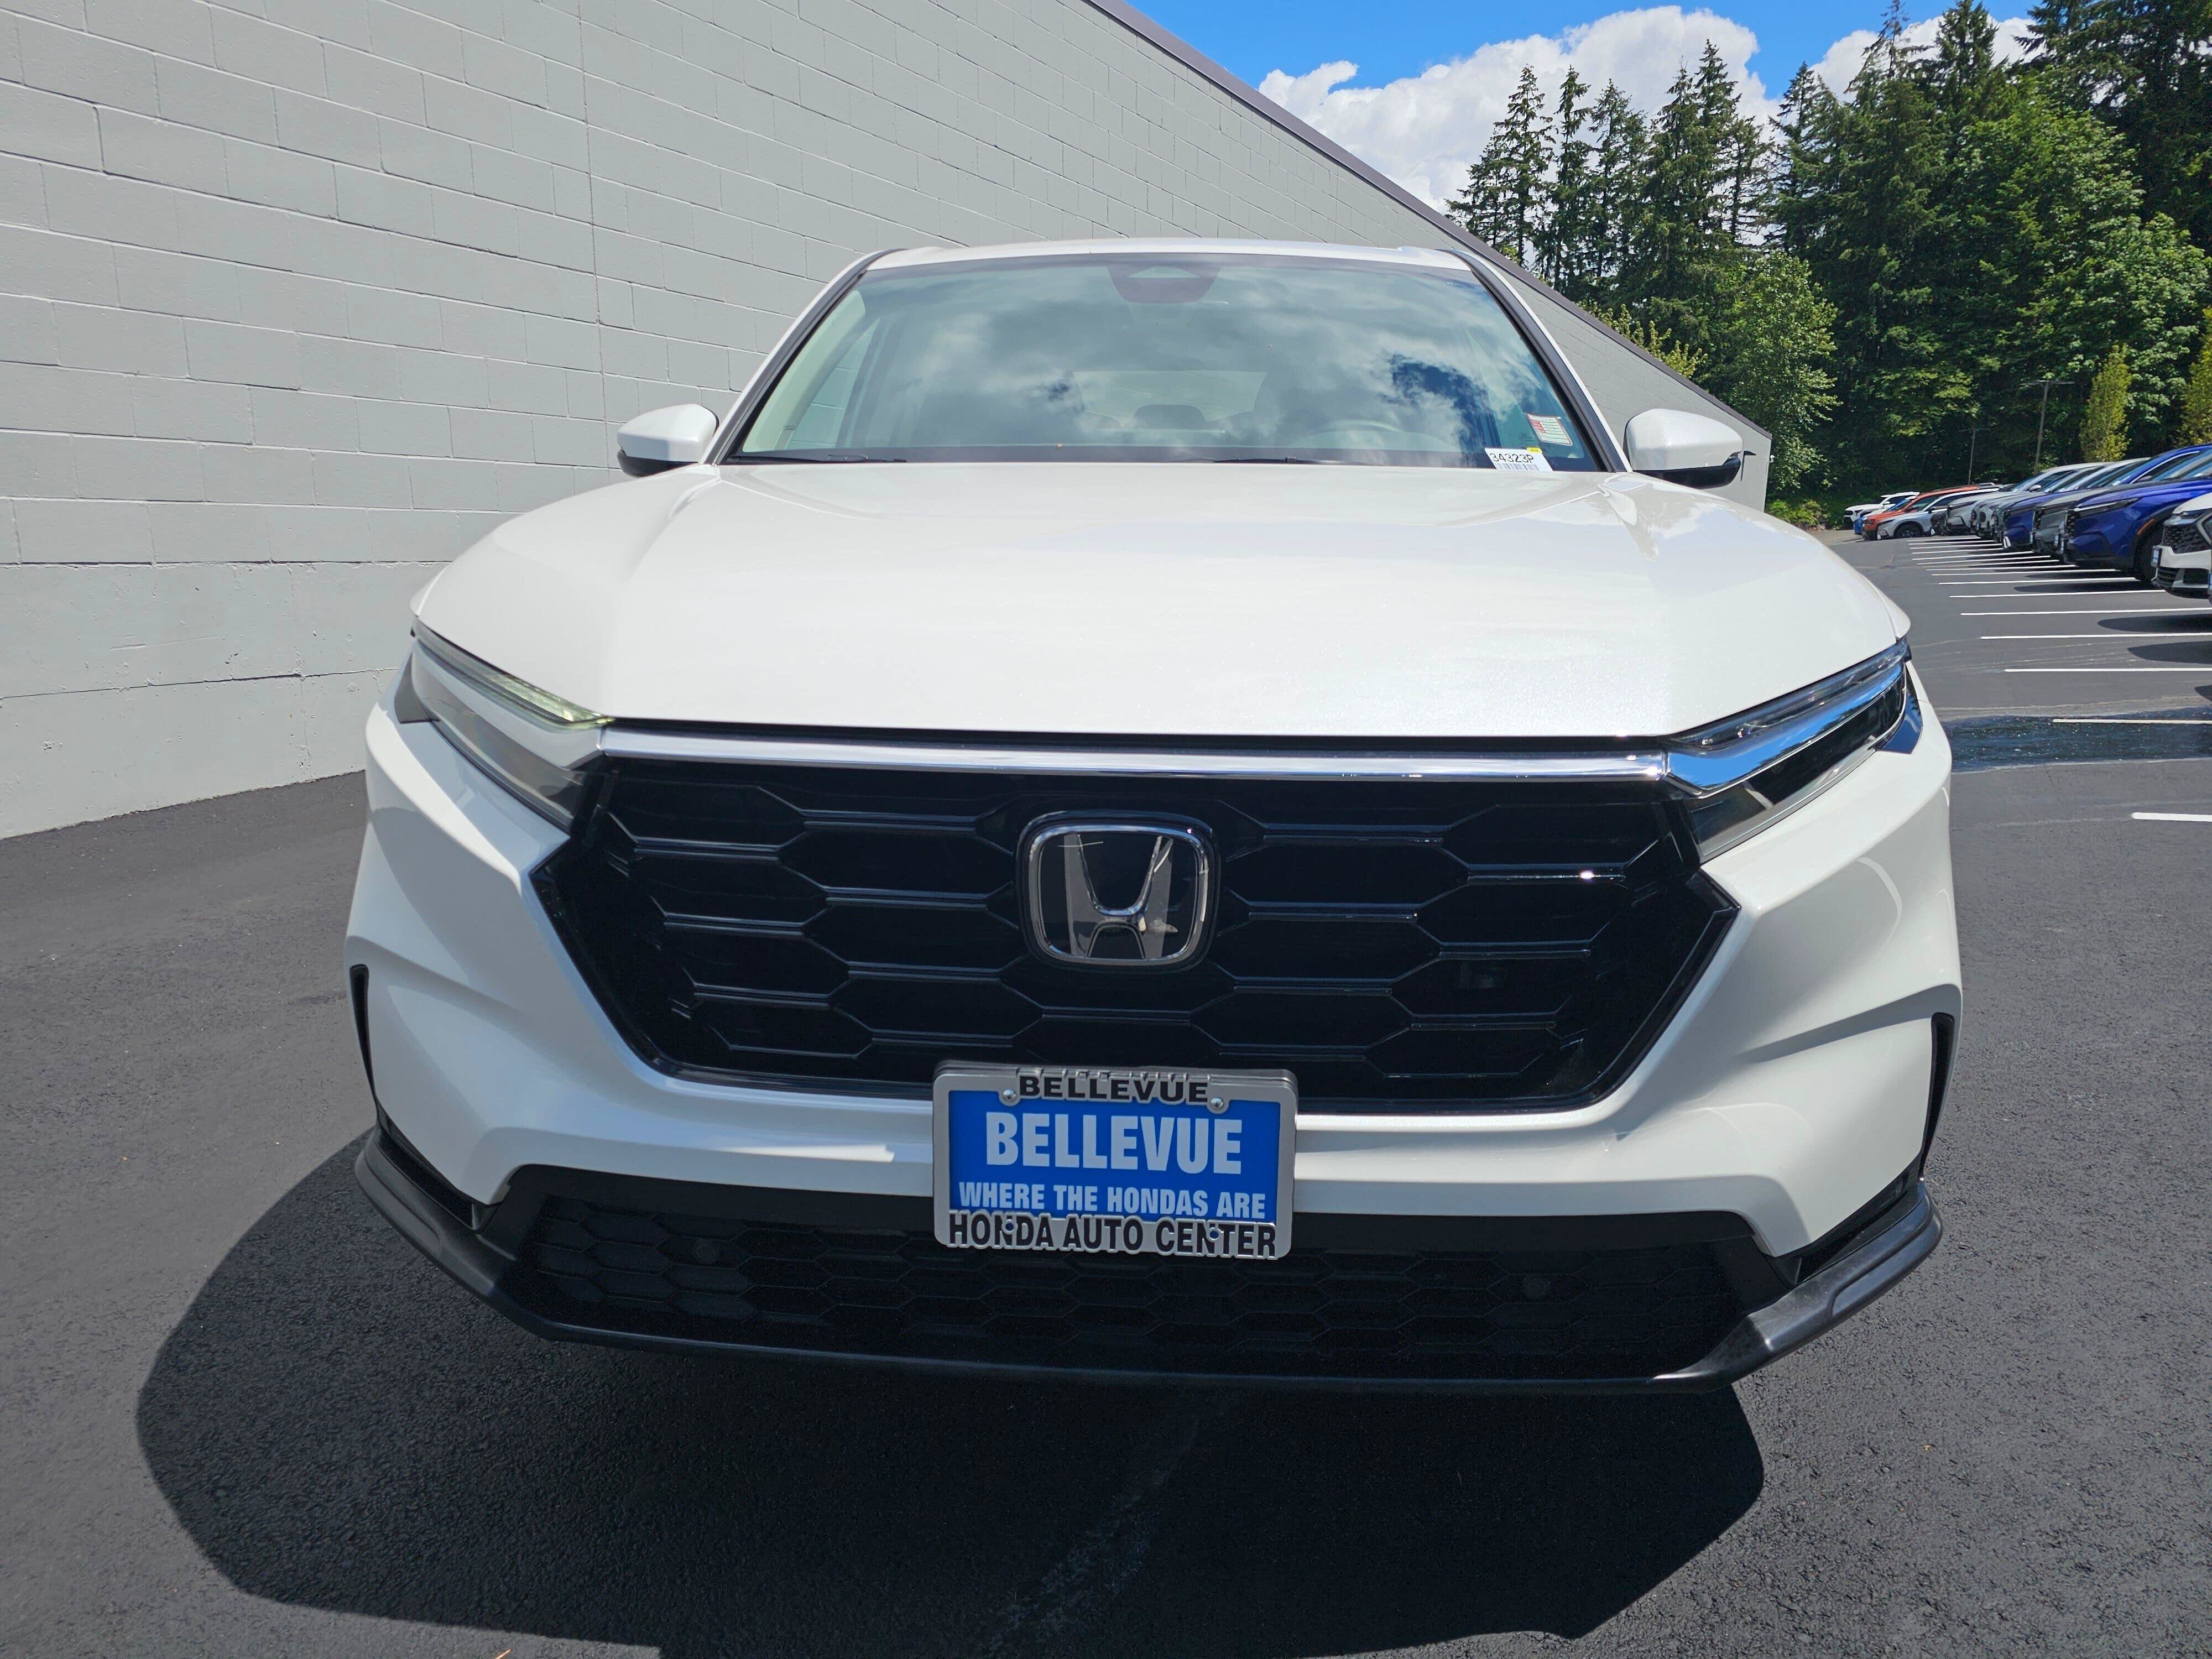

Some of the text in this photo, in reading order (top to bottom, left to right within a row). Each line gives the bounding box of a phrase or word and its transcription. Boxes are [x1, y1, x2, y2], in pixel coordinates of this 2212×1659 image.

[1490, 453, 1534, 463] 34323P
[1019, 1076, 1209, 1103] BELLEVUE
[986, 1112, 1243, 1175] BELLEVUE
[959, 1181, 1266, 1219] WHERE THE HONDAS ARE
[949, 1213, 1277, 1258] HONDA AUTO CENTER
